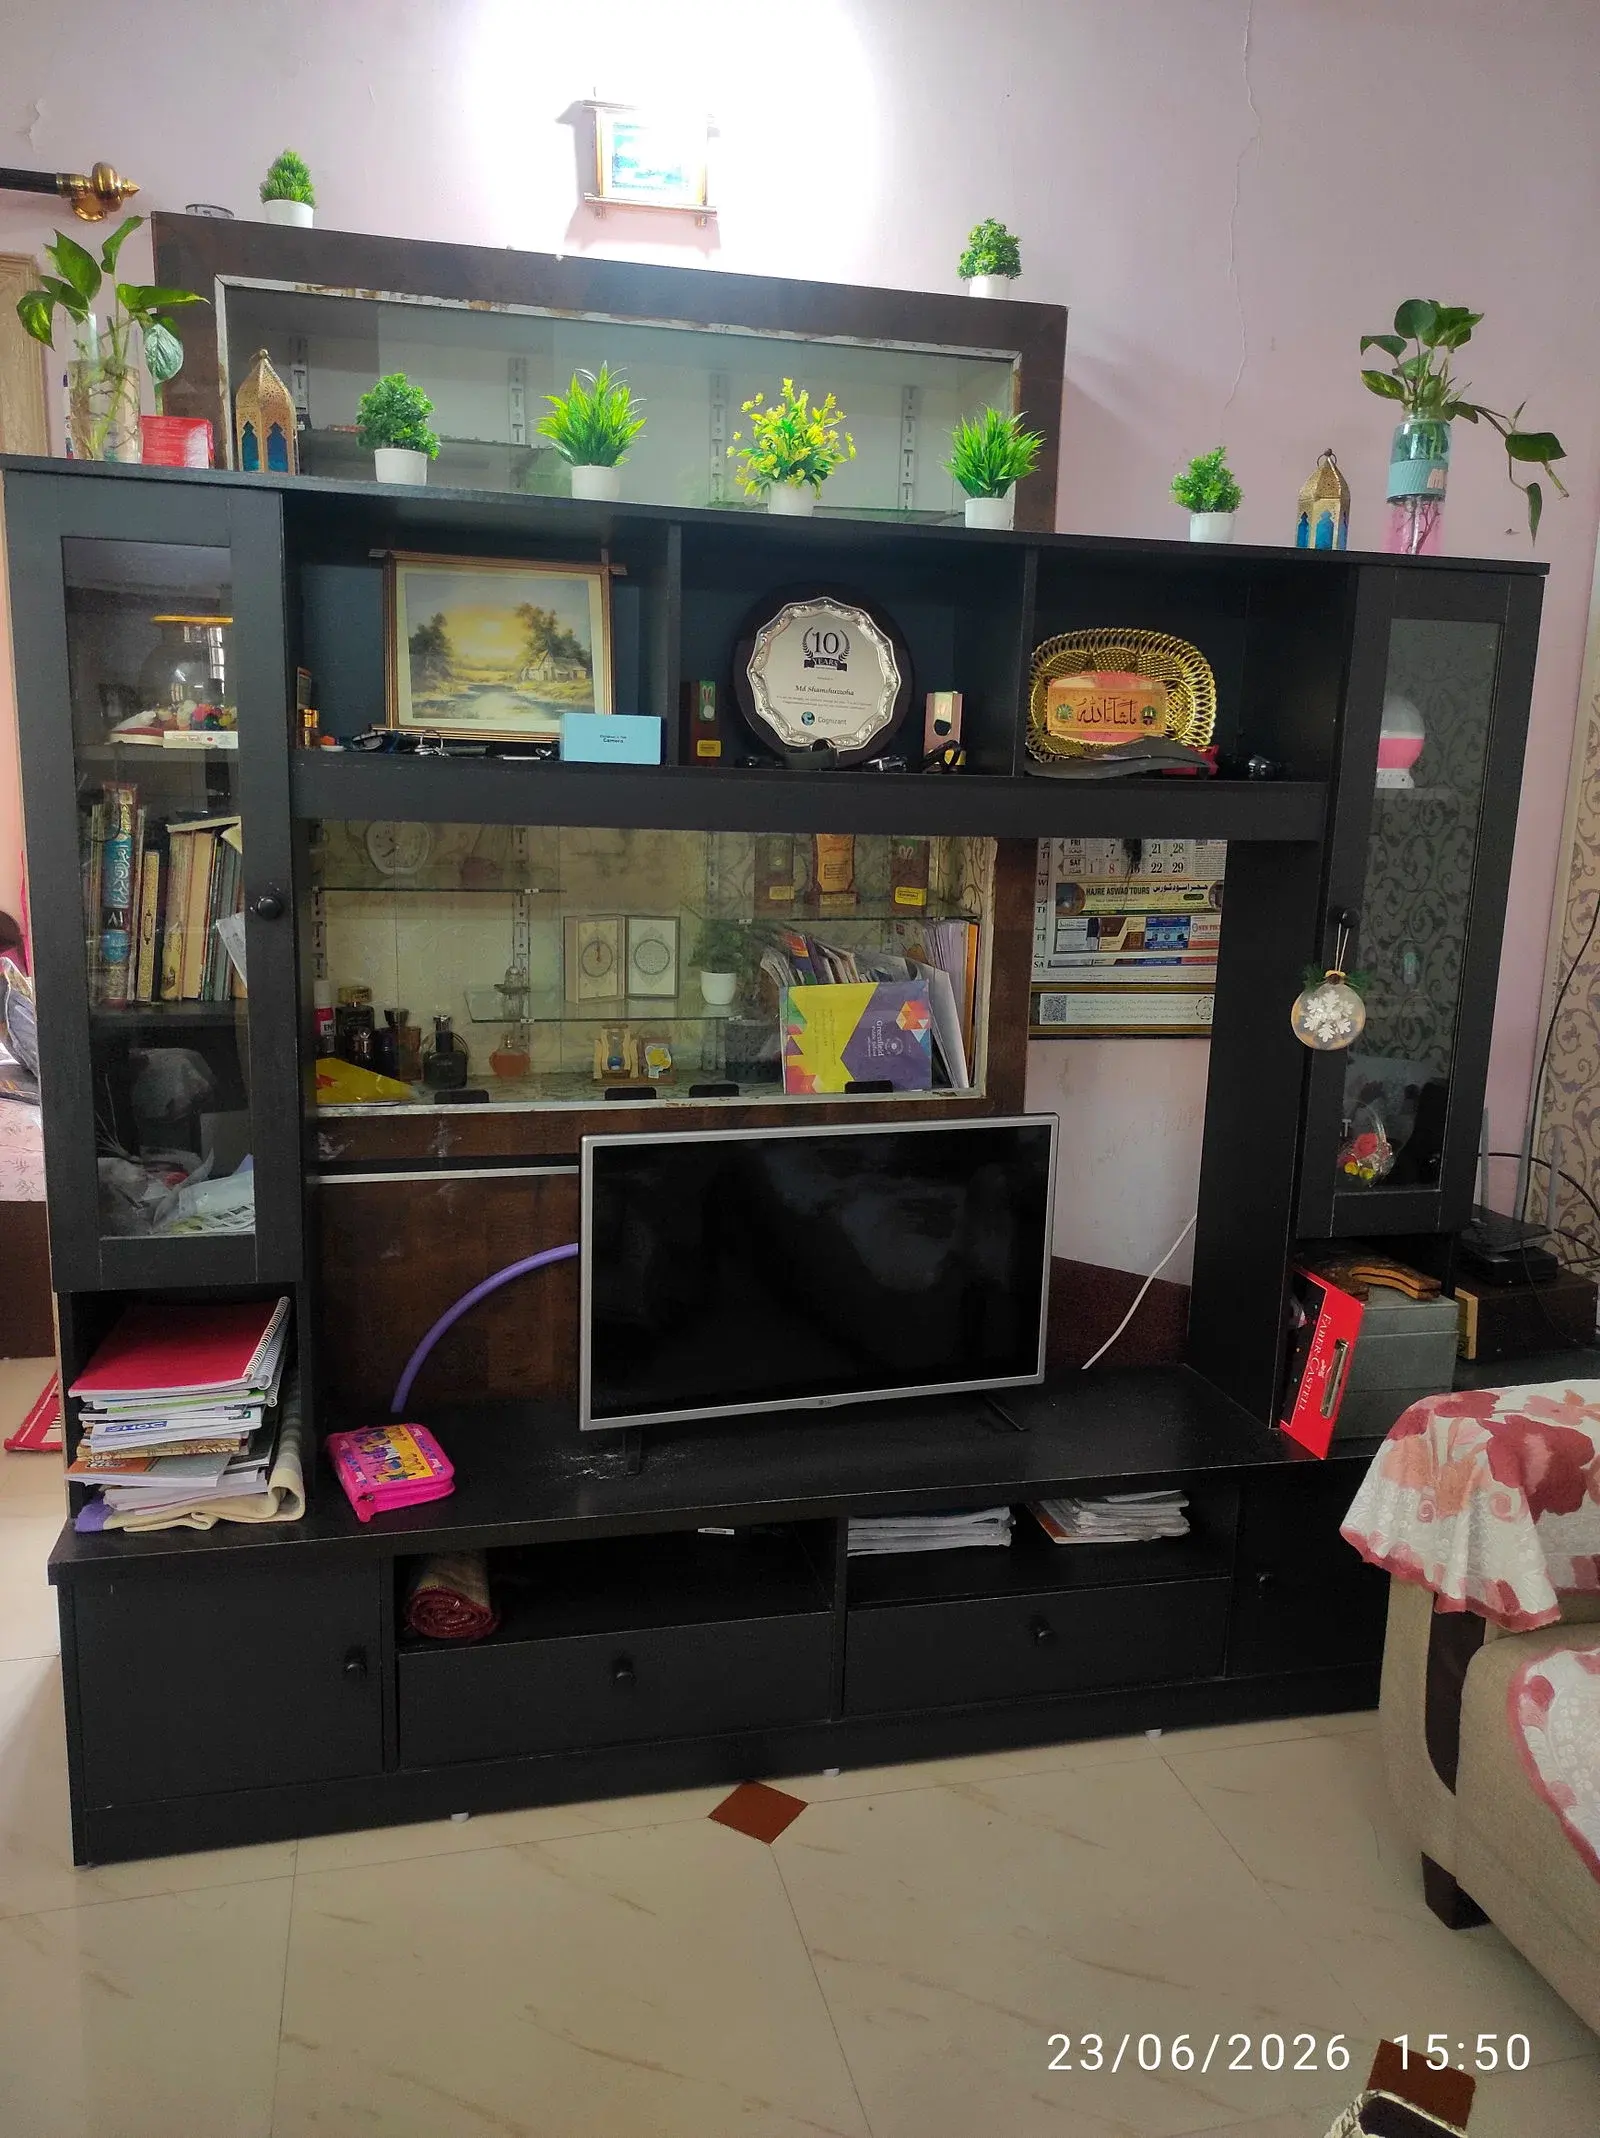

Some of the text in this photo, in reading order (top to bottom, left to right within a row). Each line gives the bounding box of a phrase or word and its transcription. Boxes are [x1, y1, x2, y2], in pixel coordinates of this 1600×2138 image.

[811, 632, 839, 655] 10
[812, 657, 839, 667] YEARS
[817, 716, 848, 726] Cognizant
[1110, 843, 1184, 855] 7 21 28
[1089, 862, 1094, 874] 1
[1108, 862, 1115, 874] 8
[1150, 862, 1162, 874] 22
[1172, 862, 1184, 874] 29
[1085, 886, 1151, 896] HAJRE ASWAD TOURS
